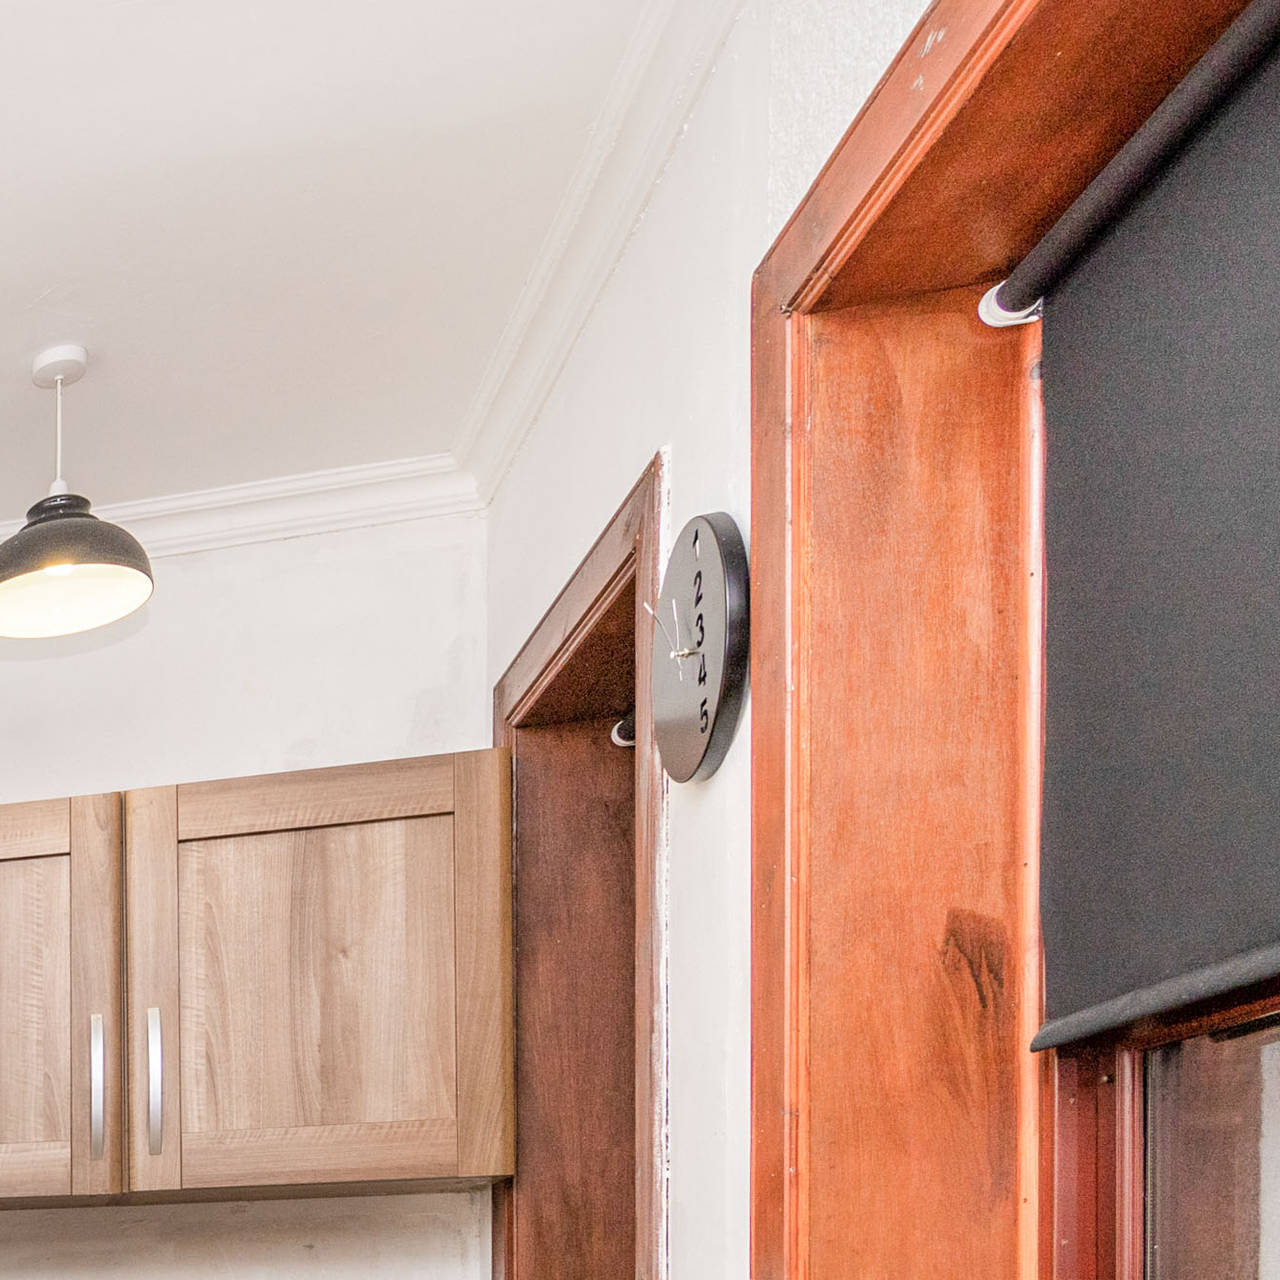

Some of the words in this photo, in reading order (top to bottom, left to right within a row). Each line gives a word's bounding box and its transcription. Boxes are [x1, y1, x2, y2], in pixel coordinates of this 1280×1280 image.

[694, 570, 703, 608] 2
[696, 613, 705, 648] 3
[697, 654, 707, 686] 4
[700, 698, 709, 734] 5
